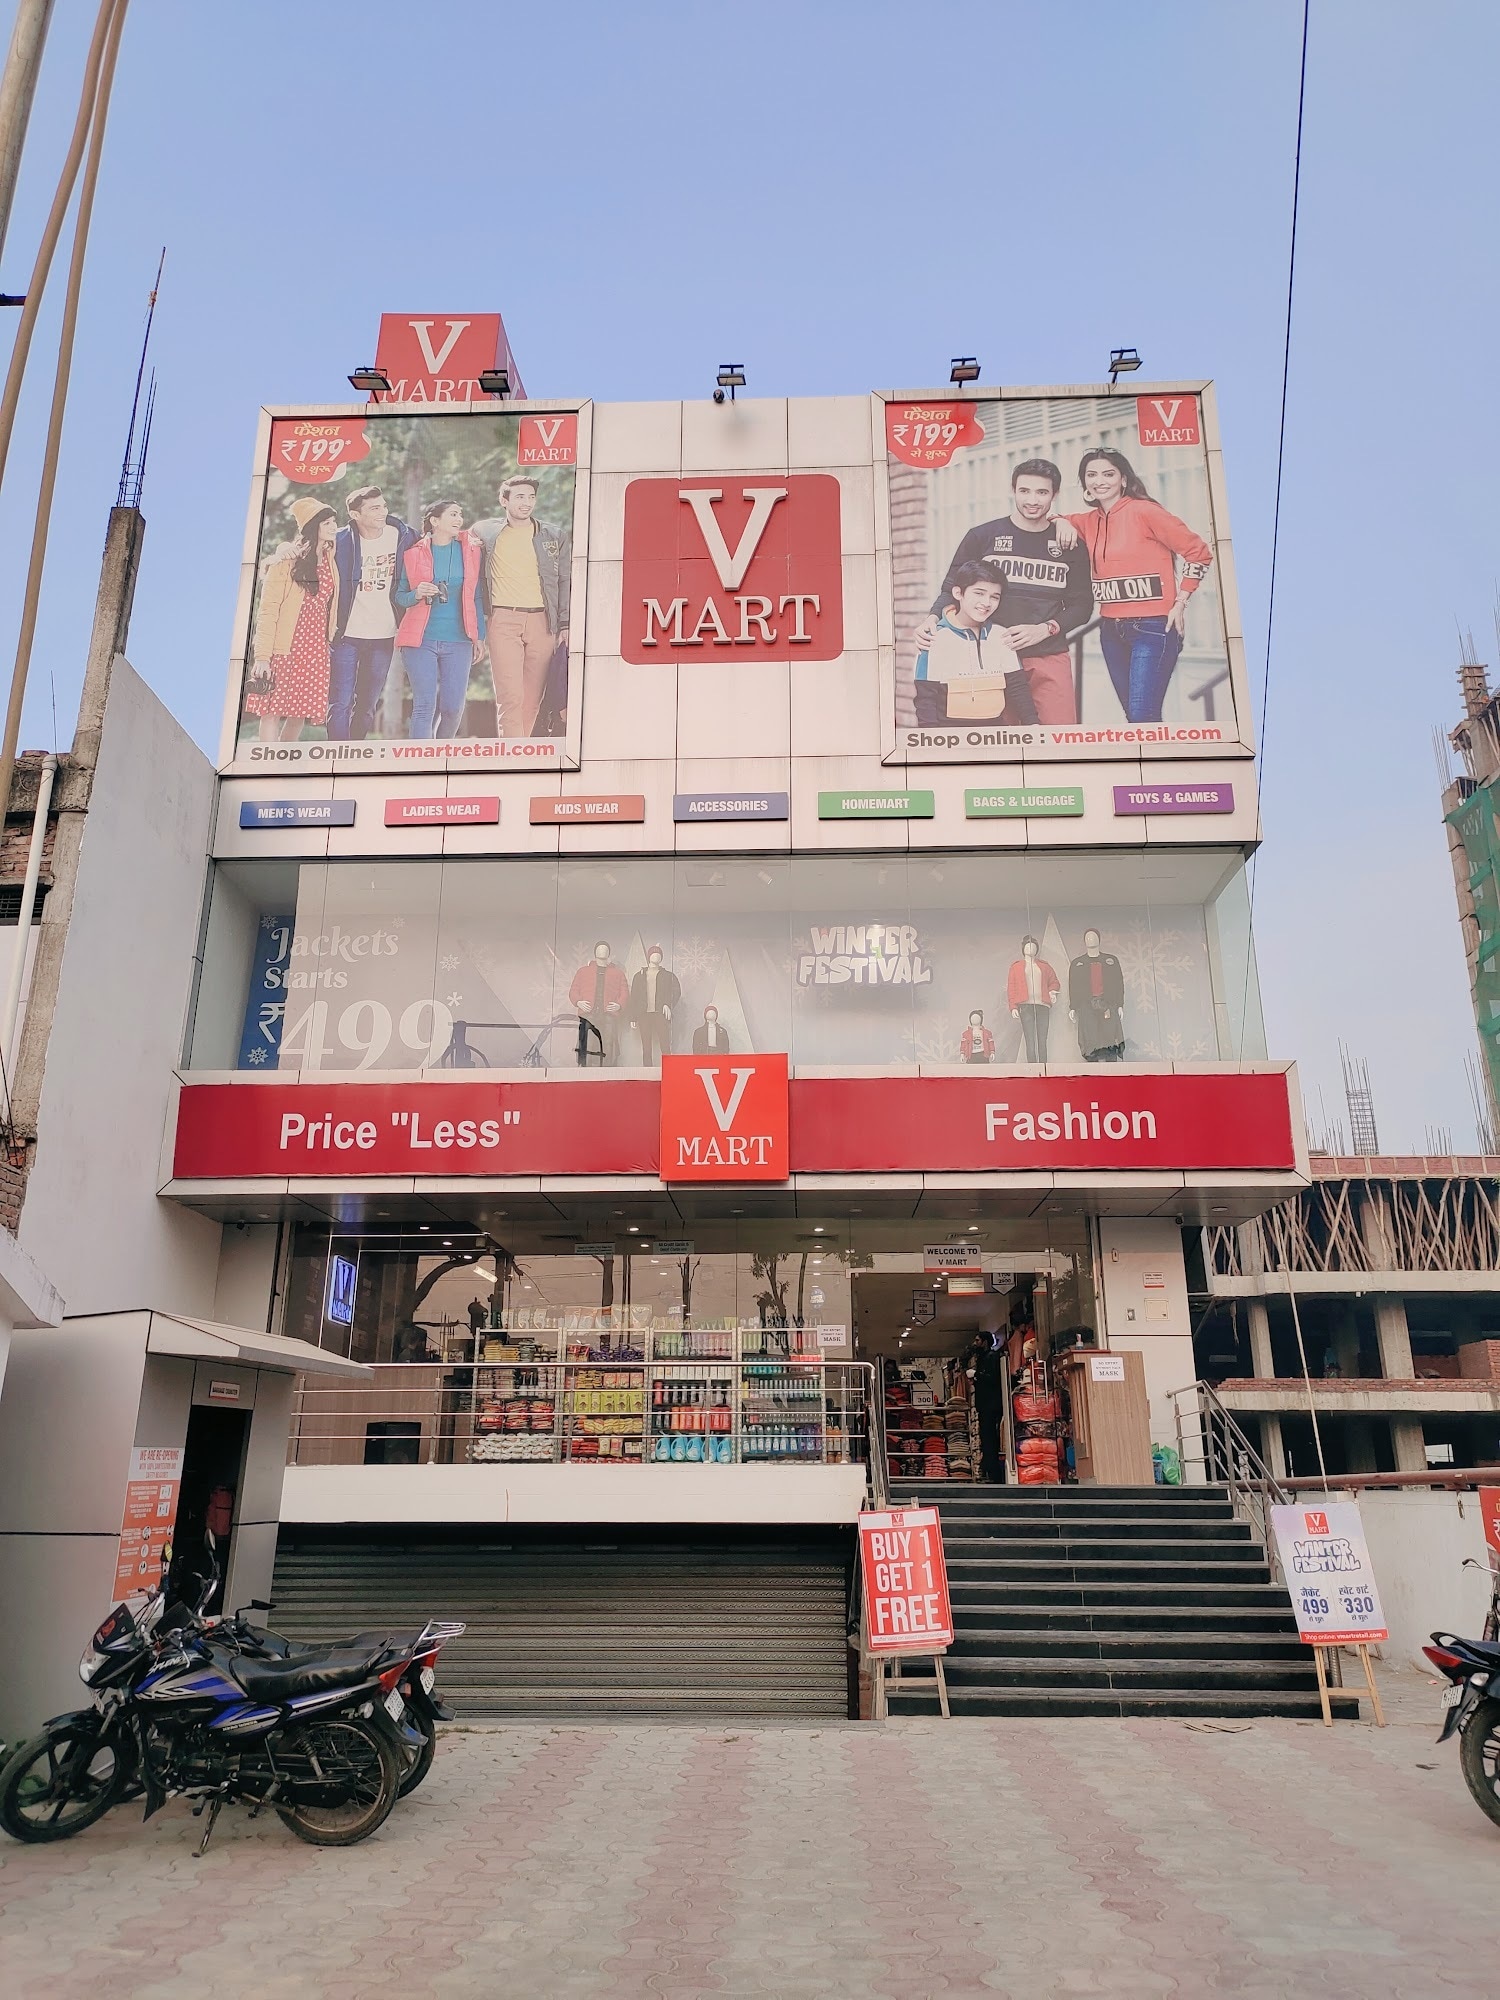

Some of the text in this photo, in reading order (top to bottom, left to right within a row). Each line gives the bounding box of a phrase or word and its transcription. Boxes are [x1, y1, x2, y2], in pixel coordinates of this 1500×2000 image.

[409, 321, 470, 374] V
[380, 379, 482, 402] MART
[904, 406, 952, 420] फैशन
[1151, 400, 1182, 428] V
[294, 422, 341, 437] फैशन
[534, 419, 564, 446] V
[1145, 429, 1194, 442] MART
[523, 448, 571, 462] MART
[910, 448, 921, 457] से
[295, 463, 307, 472] से
[679, 488, 788, 592] V
[994, 540, 1013, 548] 1979
[361, 553, 395, 567] ADE
[1124, 578, 1153, 598] ON
[641, 594, 821, 645] MART
[907, 733, 960, 748] Shop
[966, 731, 1033, 746] Online
[1052, 727, 1221, 743] vmartretail.com
[250, 747, 302, 761] Shop
[308, 745, 374, 760] Online
[392, 742, 555, 758] vmartretail.com
[689, 800, 768, 812] ACCESSORIES
[842, 798, 910, 809] HOMEMART
[973, 795, 1076, 807] BAGS & LUGGAGE
[1128, 792, 1218, 803] TOYS & GAMES
[257, 807, 331, 819] MEN'S WEAR
[402, 804, 480, 817] LADIES WEAR
[554, 803, 618, 814] KIDS WEAR
[266, 926, 399, 964] Jackets
[810, 925, 919, 956] WINTER
[264, 967, 348, 989] Starts
[800, 955, 930, 983] FESTIVAL
[694, 1068, 755, 1131] V
[279, 1110, 521, 1150] Price "Less"
[985, 1103, 1157, 1141] Fashion
[676, 1136, 773, 1165] MART
[894, 1514, 901, 1522] V
[1309, 1514, 1321, 1526] V
[871, 1529, 931, 1561] BUY 1
[1294, 1538, 1352, 1557] WINTER
[1293, 1555, 1361, 1573] FESTIVAL
[875, 1560, 934, 1592] GET 1
